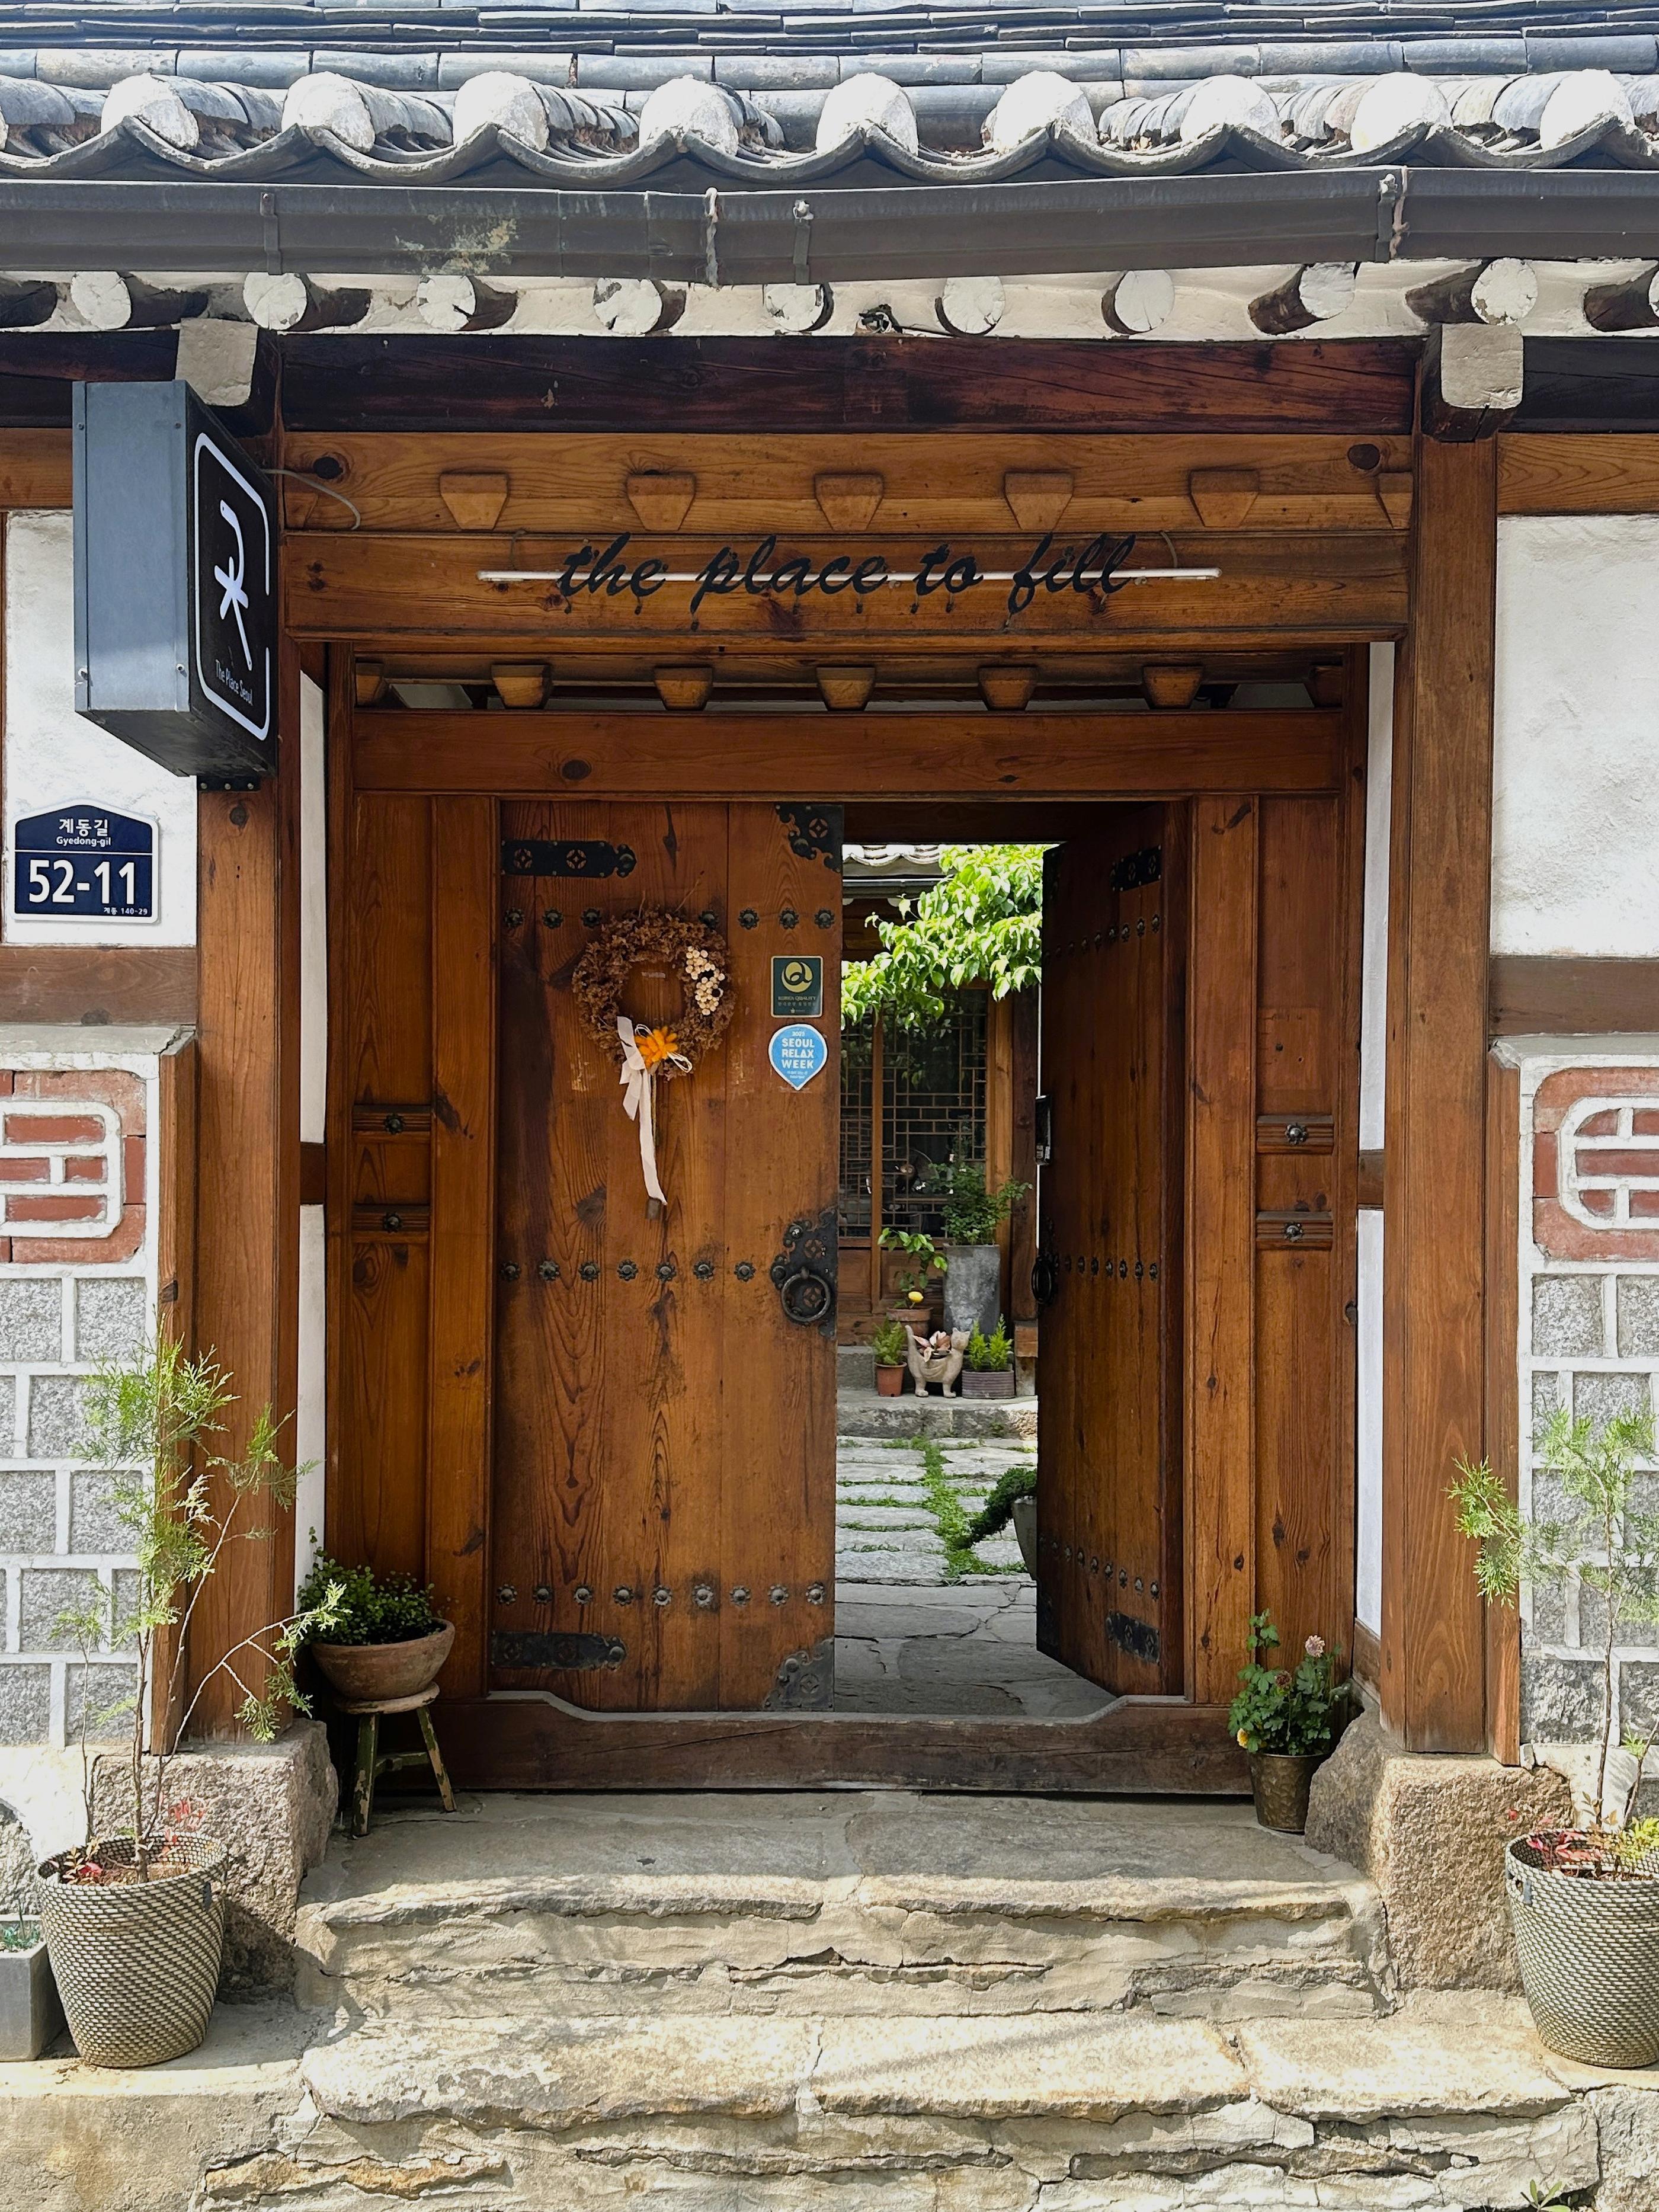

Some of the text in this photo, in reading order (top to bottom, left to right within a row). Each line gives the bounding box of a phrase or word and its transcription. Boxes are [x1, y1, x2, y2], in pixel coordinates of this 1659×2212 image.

[558, 532, 1136, 614] the place to fill
[215, 659, 253, 706] The Place Seoul
[59, 818, 108, 837] 계동길
[56, 836, 111, 847] Gyedong-gil
[28, 859, 135, 905] 52-11
[121, 907, 148, 915] 140-29
[782, 1038, 815, 1048] SEOUL
[782, 1048, 815, 1059] RELAX
[781, 1059, 814, 1069] WEEK
